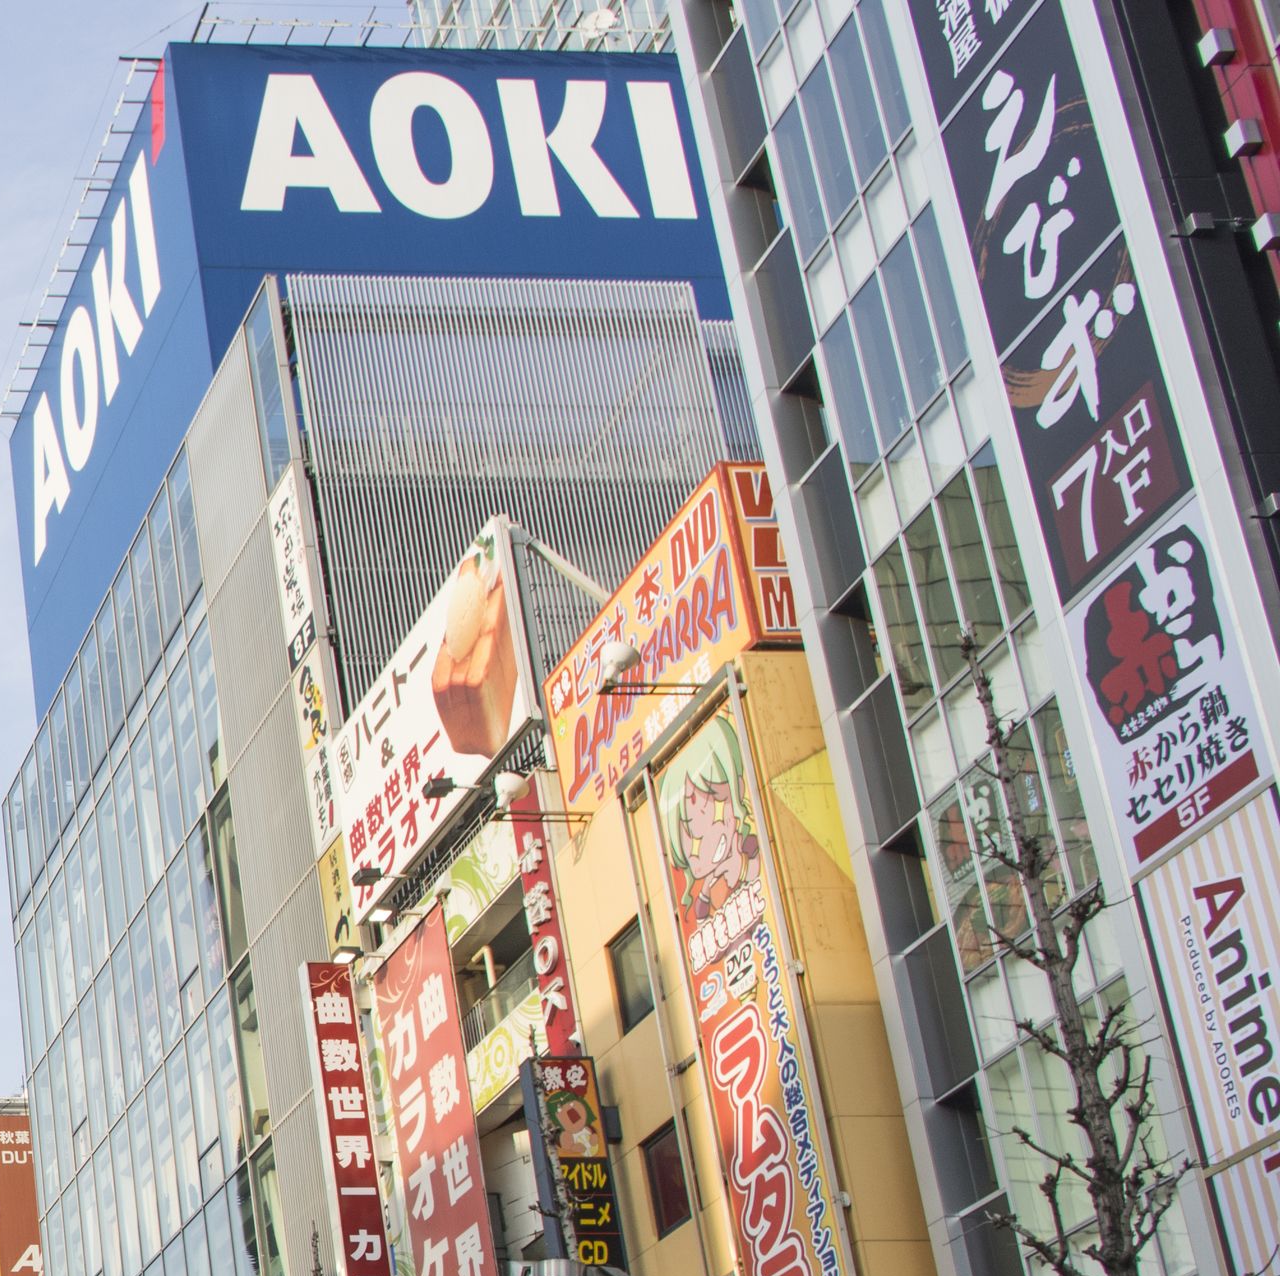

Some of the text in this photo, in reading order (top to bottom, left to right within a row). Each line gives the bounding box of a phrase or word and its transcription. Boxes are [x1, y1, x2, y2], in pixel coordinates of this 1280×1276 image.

[241, 72, 698, 219] AOKI
[34, 150, 162, 566] AOKI
[1100, 398, 1152, 476] 入口
[1051, 446, 1153, 563] 7F
[293, 617, 313, 665] 8F
[353, 643, 428, 762] ハニトー
[1126, 685, 1230, 790] 赤から鍋
[349, 728, 441, 860] 曲数世界一
[1125, 715, 1249, 825] セセリ焼き
[1176, 786, 1213, 829] 5F
[354, 766, 448, 910] カラオケ
[726, 941, 754, 978] DVD
[1180, 915, 1240, 1120] Produced by ADORES
[1193, 876, 1280, 1127] Anime
[315, 992, 377, 1197] 曲数世界一
[578, 1240, 608, 1264] CD
